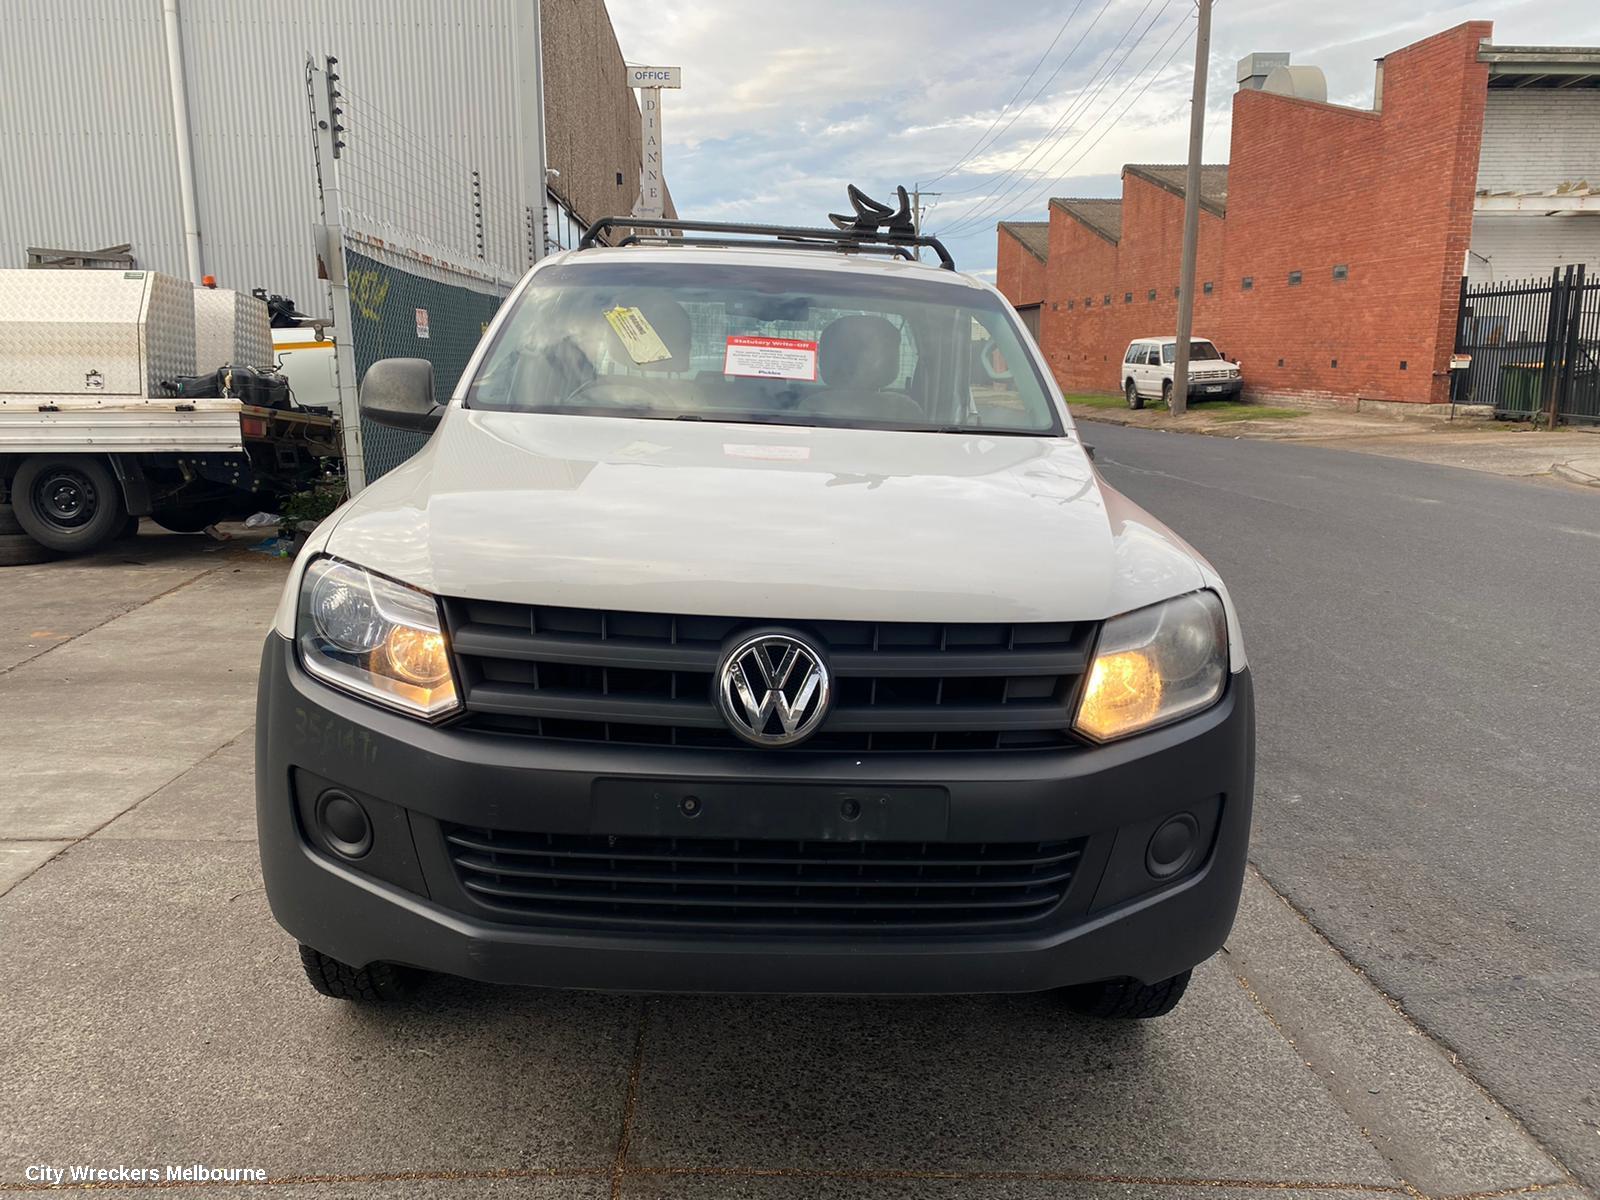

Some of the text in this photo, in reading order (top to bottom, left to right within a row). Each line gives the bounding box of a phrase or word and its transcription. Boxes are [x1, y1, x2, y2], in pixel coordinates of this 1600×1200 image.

[635, 71, 671, 80] OFFICE
[646, 100, 658, 198] DIANNE
[734, 339, 771, 347] Statutory
